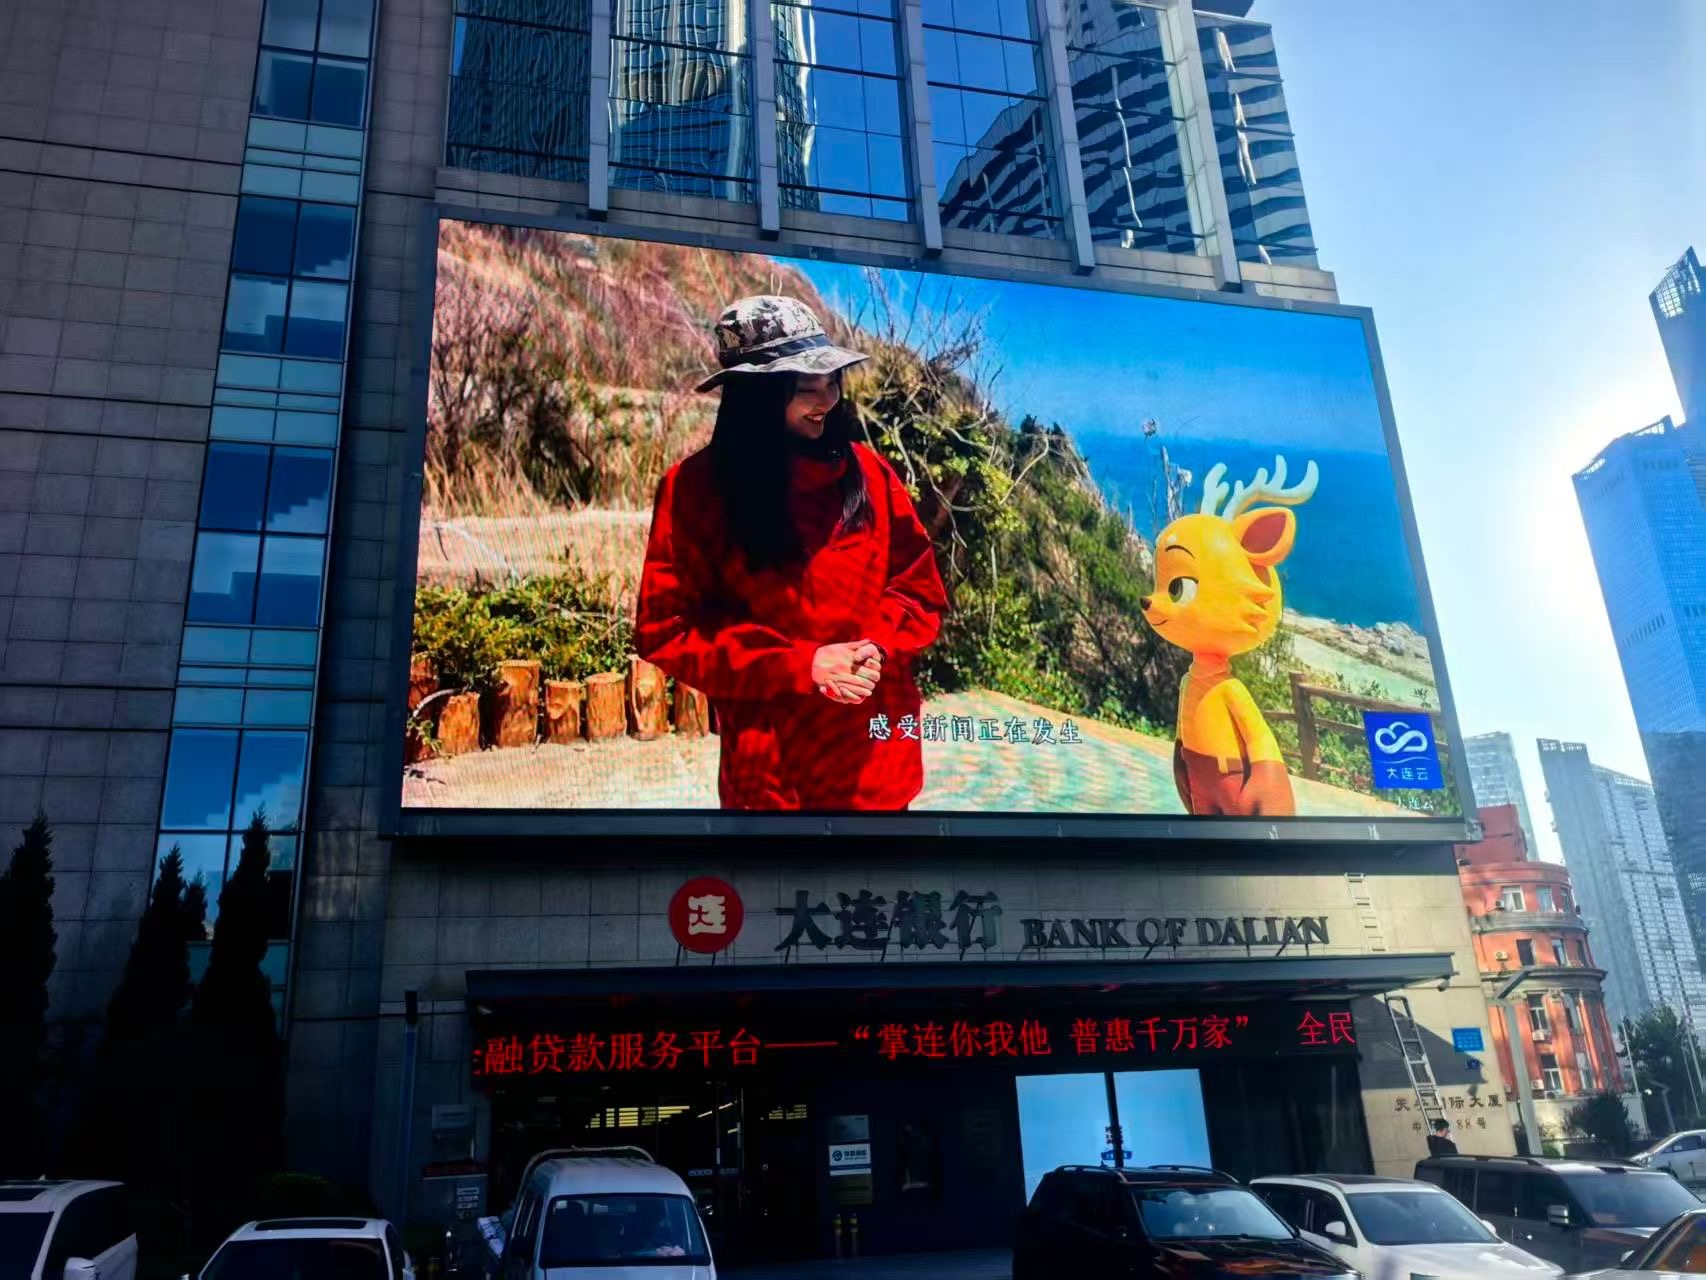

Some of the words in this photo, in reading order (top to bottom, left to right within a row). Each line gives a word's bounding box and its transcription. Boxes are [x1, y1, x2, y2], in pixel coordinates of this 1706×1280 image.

[868, 713, 1082, 745] 感受新闻正在发生
[1385, 767, 1429, 781] 大连云
[1020, 917, 1130, 948] BANK
[1135, 916, 1188, 947] OF
[1195, 915, 1329, 945] DALIAN
[1296, 1010, 1356, 1045] 全民
